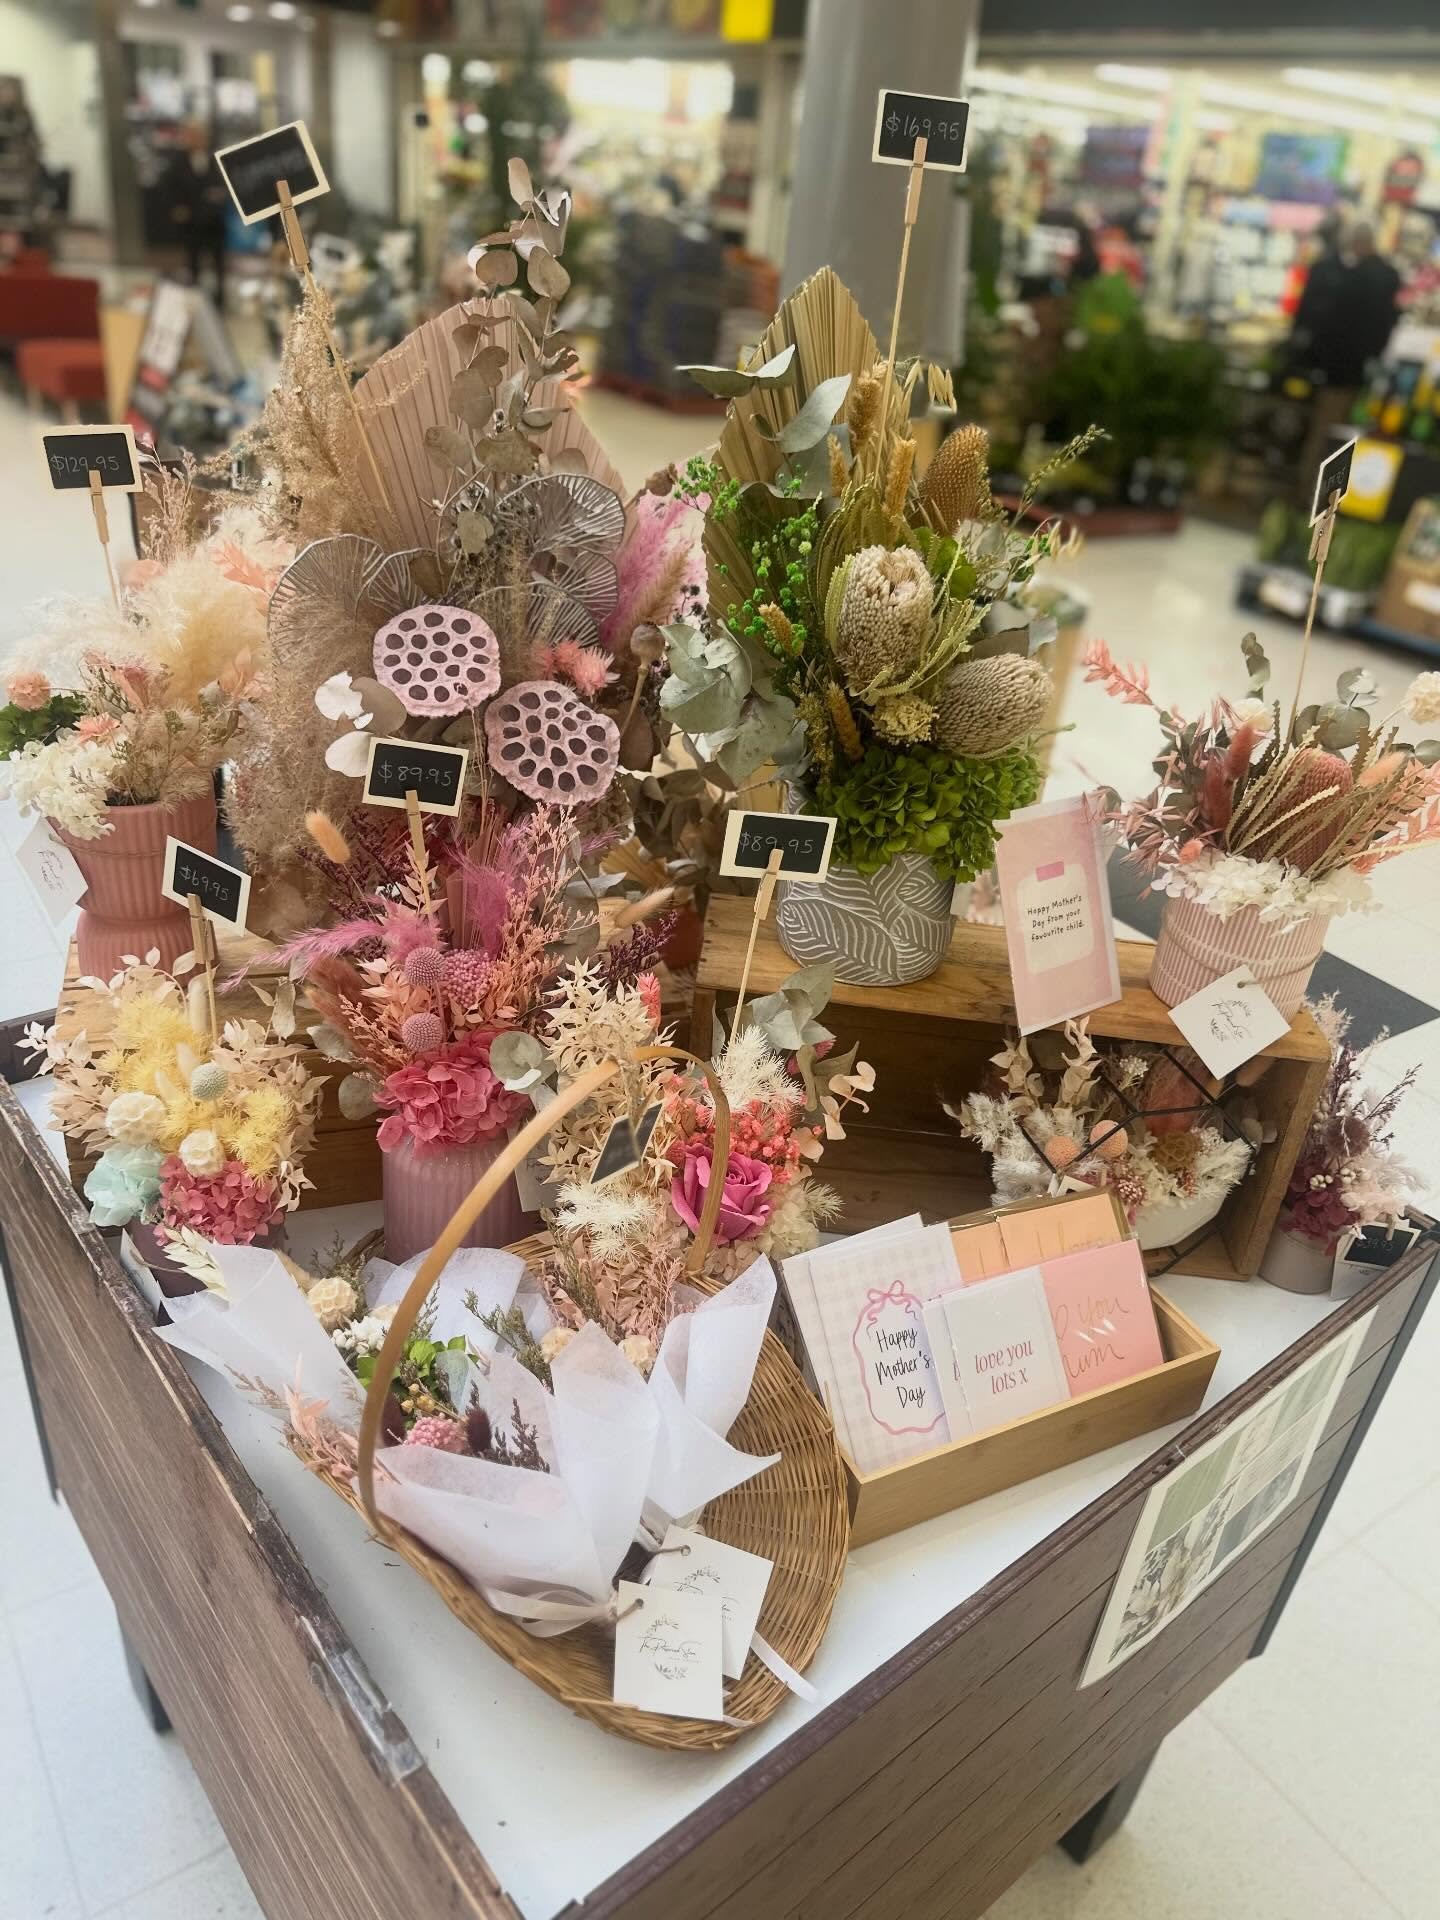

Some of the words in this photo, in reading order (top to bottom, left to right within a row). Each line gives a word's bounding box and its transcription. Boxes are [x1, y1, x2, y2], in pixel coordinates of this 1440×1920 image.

[885, 109, 960, 141] $169.95
[50, 453, 120, 477] $129.95
[377, 759, 453, 787] $89.95
[740, 831, 814, 855] $89.95
[179, 865, 229, 901] $69.95
[1028, 906, 1050, 915] Happy
[1052, 894, 1082, 908] Mother's
[1032, 920, 1044, 928] Day
[1047, 915, 1063, 924] from
[1066, 909, 1080, 920] your
[1031, 927, 1063, 941] favourite
[876, 1328, 917, 1352] Happy
[875, 1350, 931, 1386] Mother's
[974, 1350, 1004, 1375] love
[1007, 1340, 1033, 1367] you
[991, 1373, 1017, 1395] lots
[1019, 1367, 1029, 1385] x
[897, 1386, 926, 1409] Day
